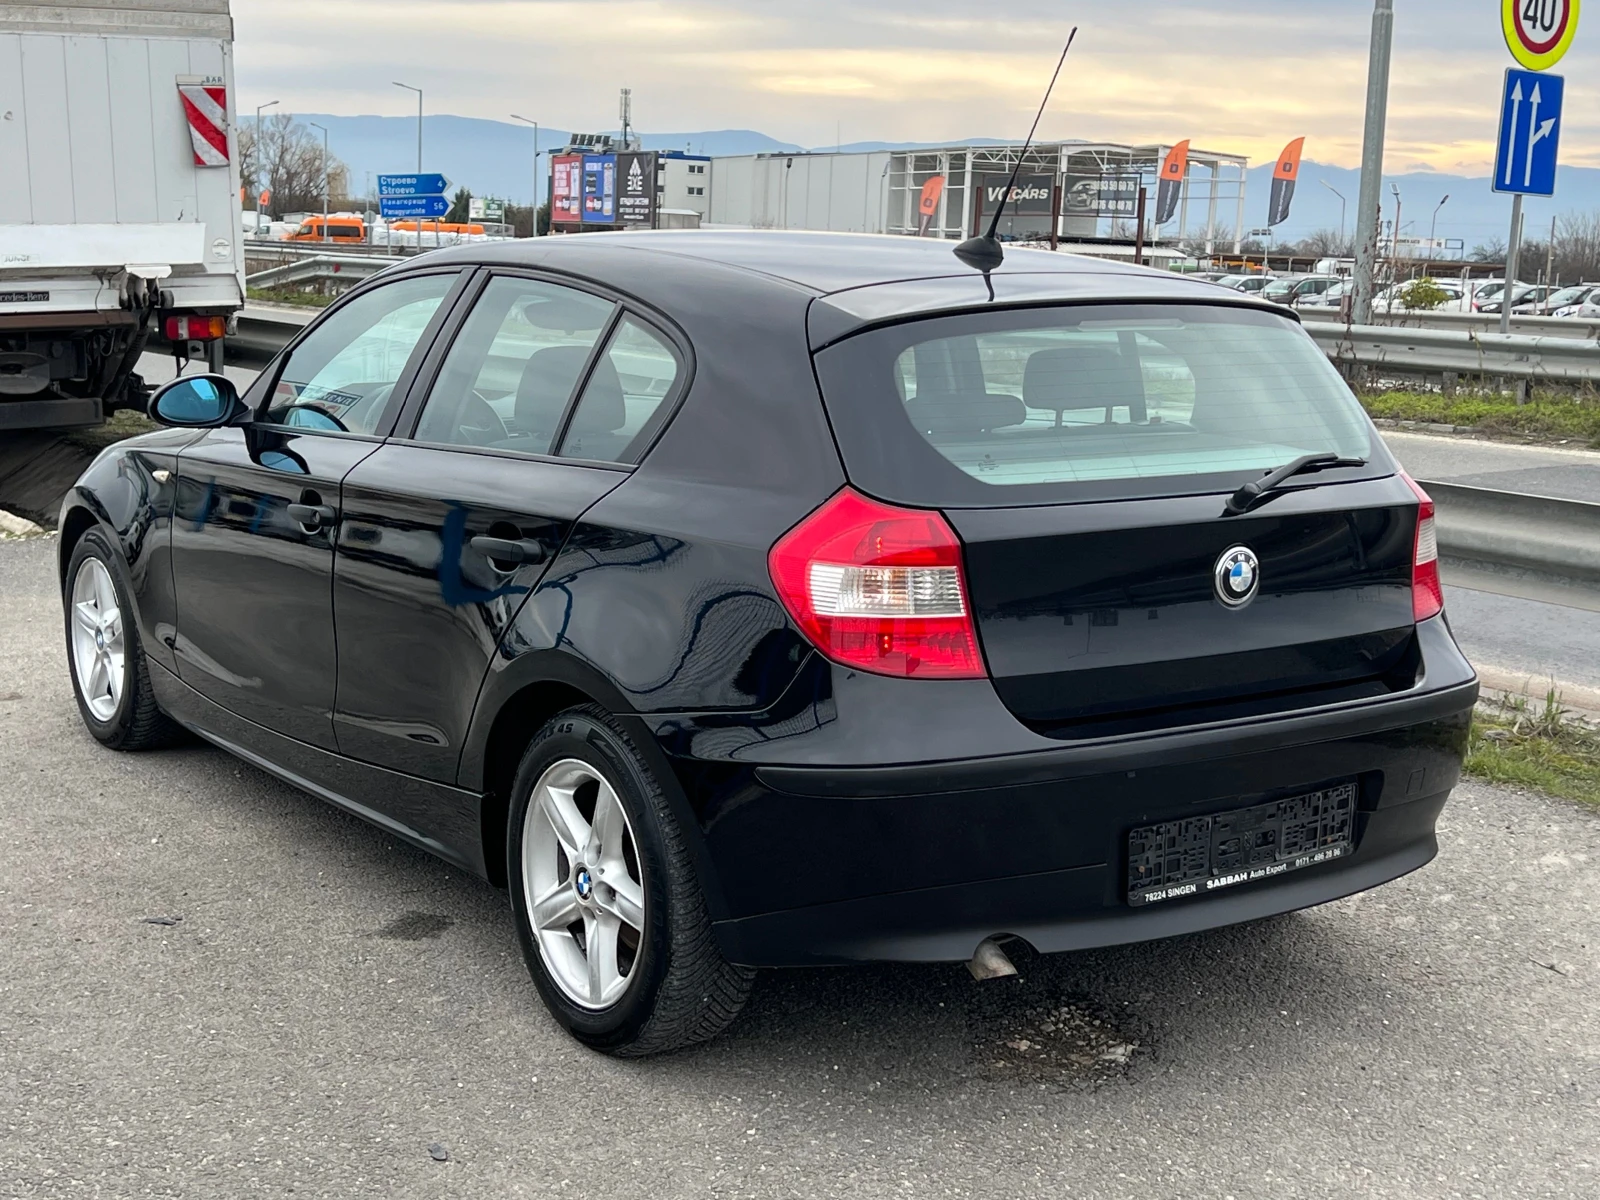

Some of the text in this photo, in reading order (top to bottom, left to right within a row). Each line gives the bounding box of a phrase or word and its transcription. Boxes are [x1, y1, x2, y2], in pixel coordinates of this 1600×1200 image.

[1522, 0, 1557, 32] 40
[380, 176, 417, 187] Строево
[381, 186, 416, 194] Stroevo
[433, 202, 444, 211] 56
[1225, 553, 1256, 570] BMW
[1145, 890, 1167, 902] 78224
[1167, 884, 1197, 898] SINGEN
[1206, 872, 1248, 889] SABBAH
[1249, 869, 1266, 879] Auto
[1266, 863, 1287, 875] Export
